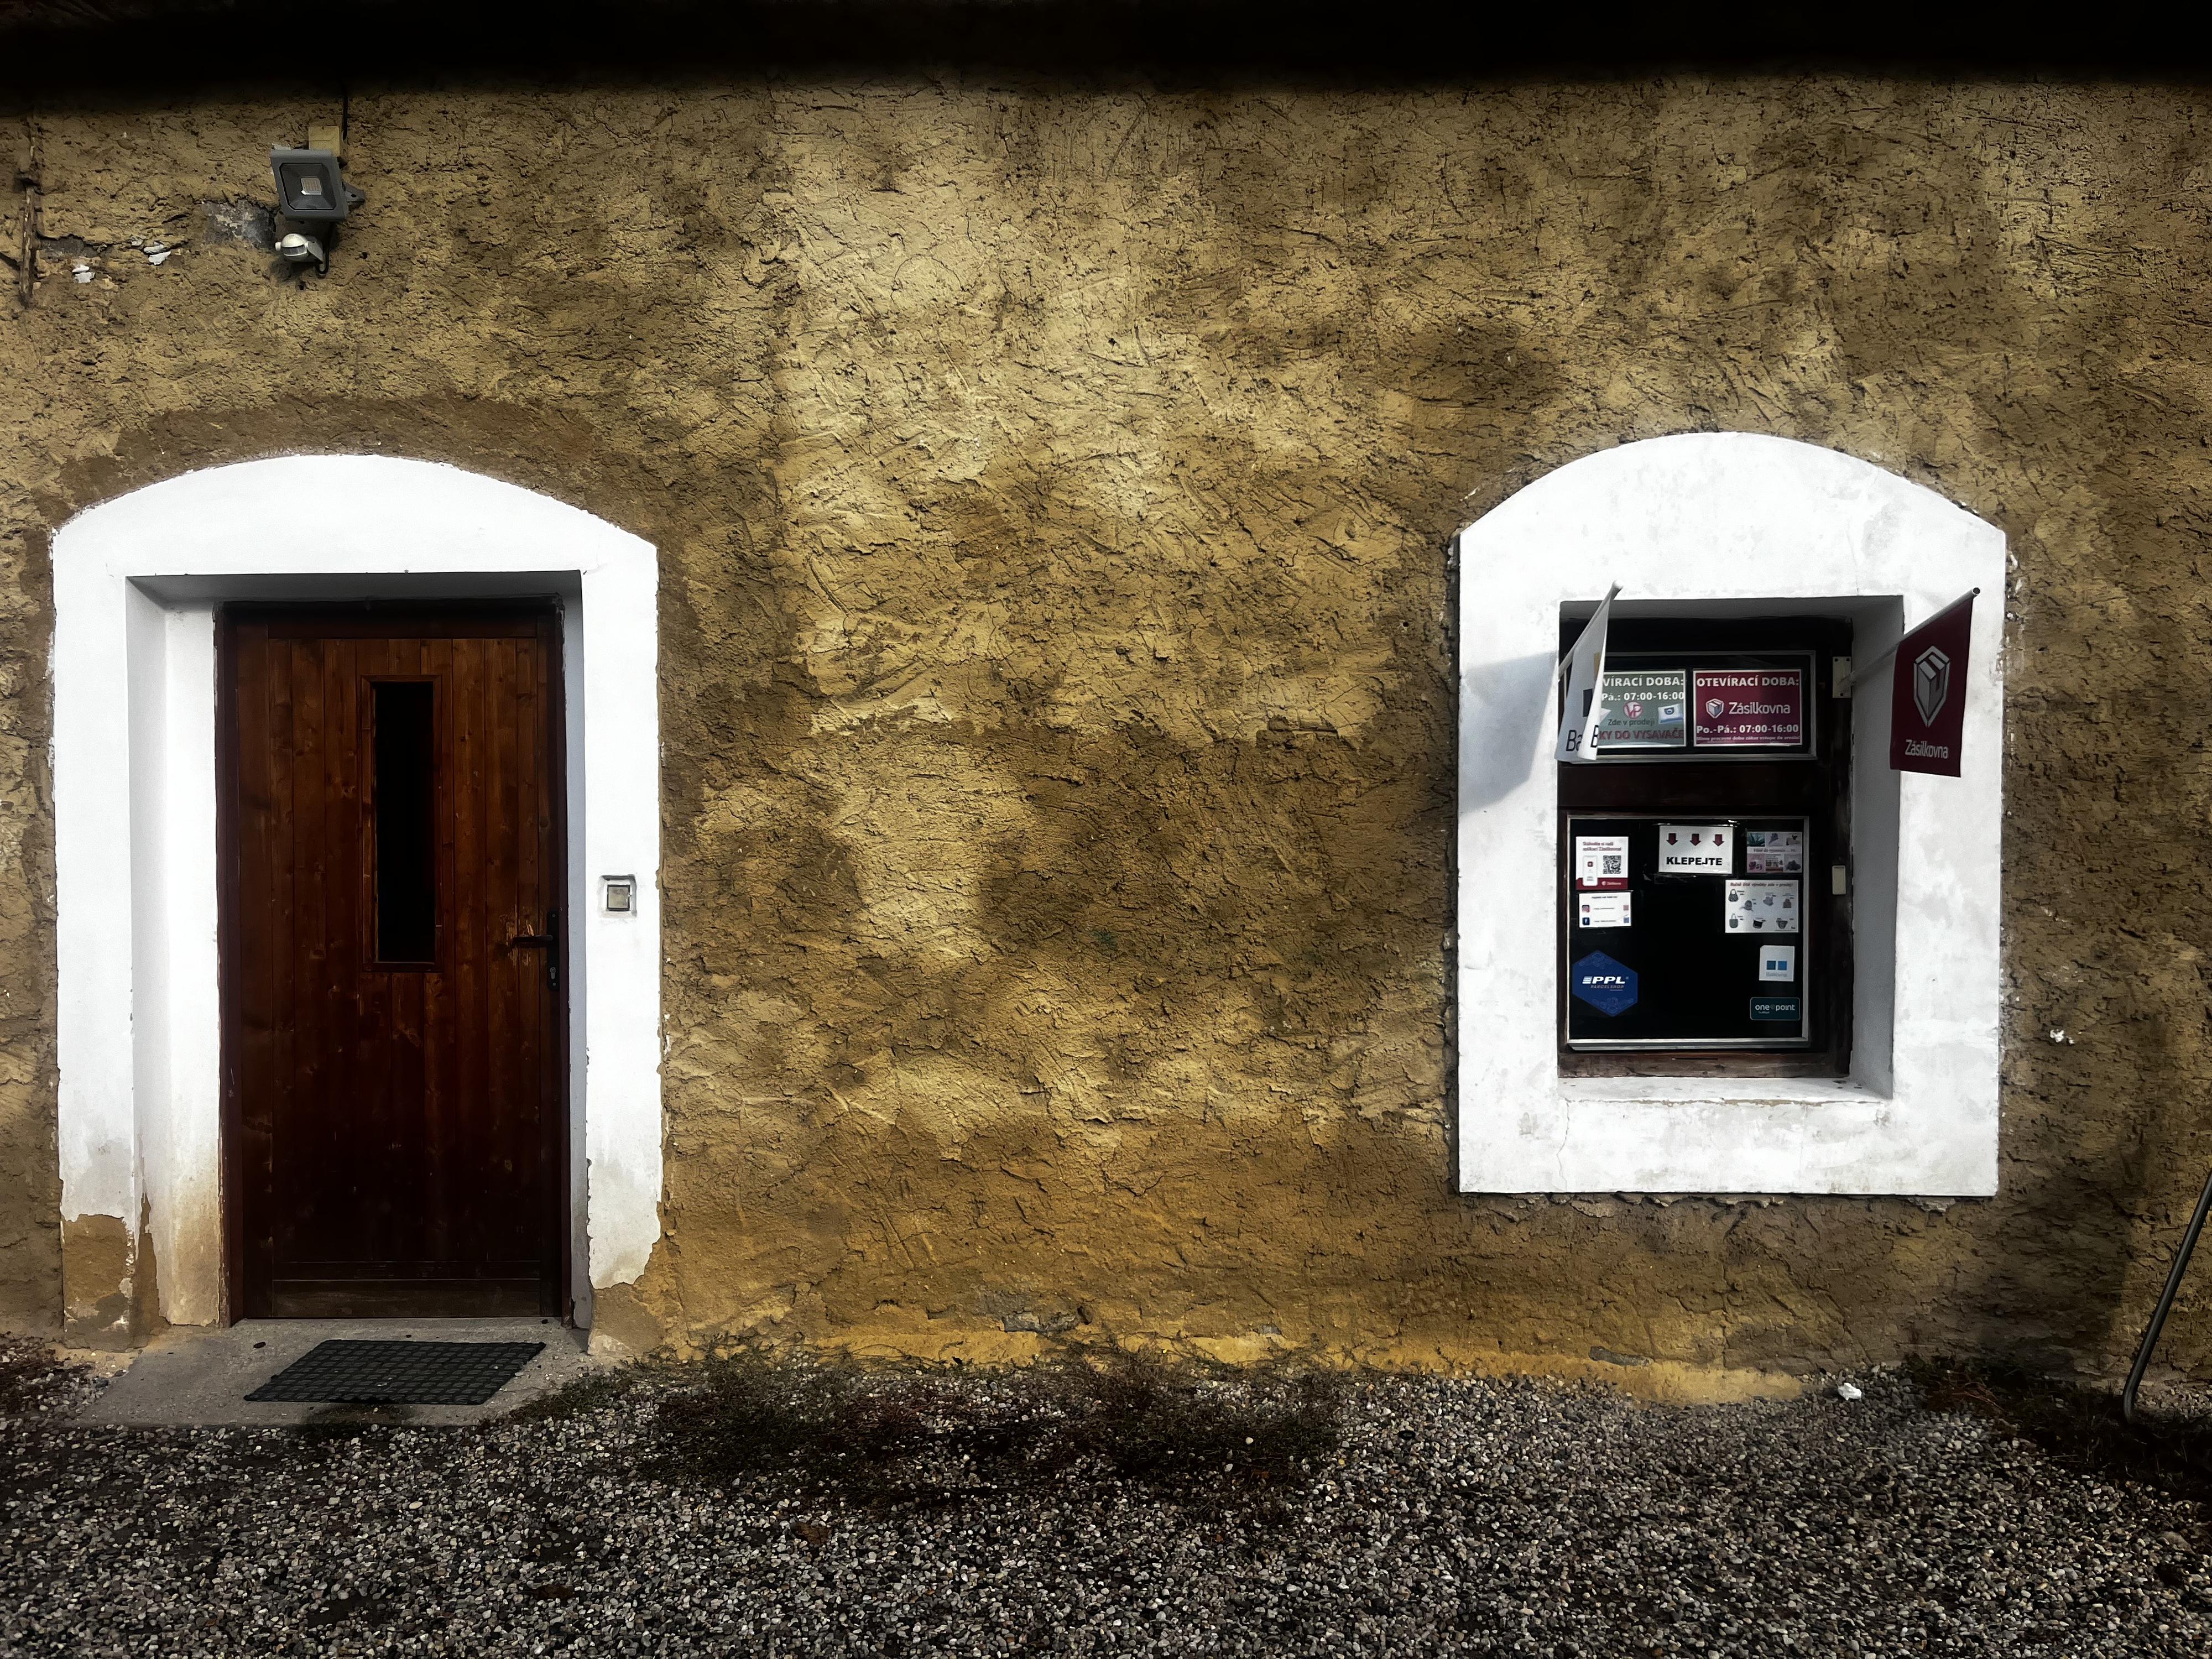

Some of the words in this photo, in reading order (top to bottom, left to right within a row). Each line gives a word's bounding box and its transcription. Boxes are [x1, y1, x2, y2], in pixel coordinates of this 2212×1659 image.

[1603, 675, 1642, 687] VÍRACÍ
[1646, 676, 1684, 686] DOBA:
[1696, 675, 1759, 687] OTEVÍRACÍ
[1761, 676, 1799, 686] DOBA:
[1601, 692, 1621, 701] Pá.:
[1624, 691, 1684, 701] 07:00-16:00
[1728, 701, 1791, 714] Zásilkovna
[1629, 719, 1655, 727] prodeji
[1739, 724, 1799, 733] 07:00-16:00
[1614, 730, 1630, 740] DO
[1905, 739, 1948, 759] Zásilkovna
[1666, 857, 1723, 866] KLEPEJTE
[1592, 976, 1626, 984] PPL
